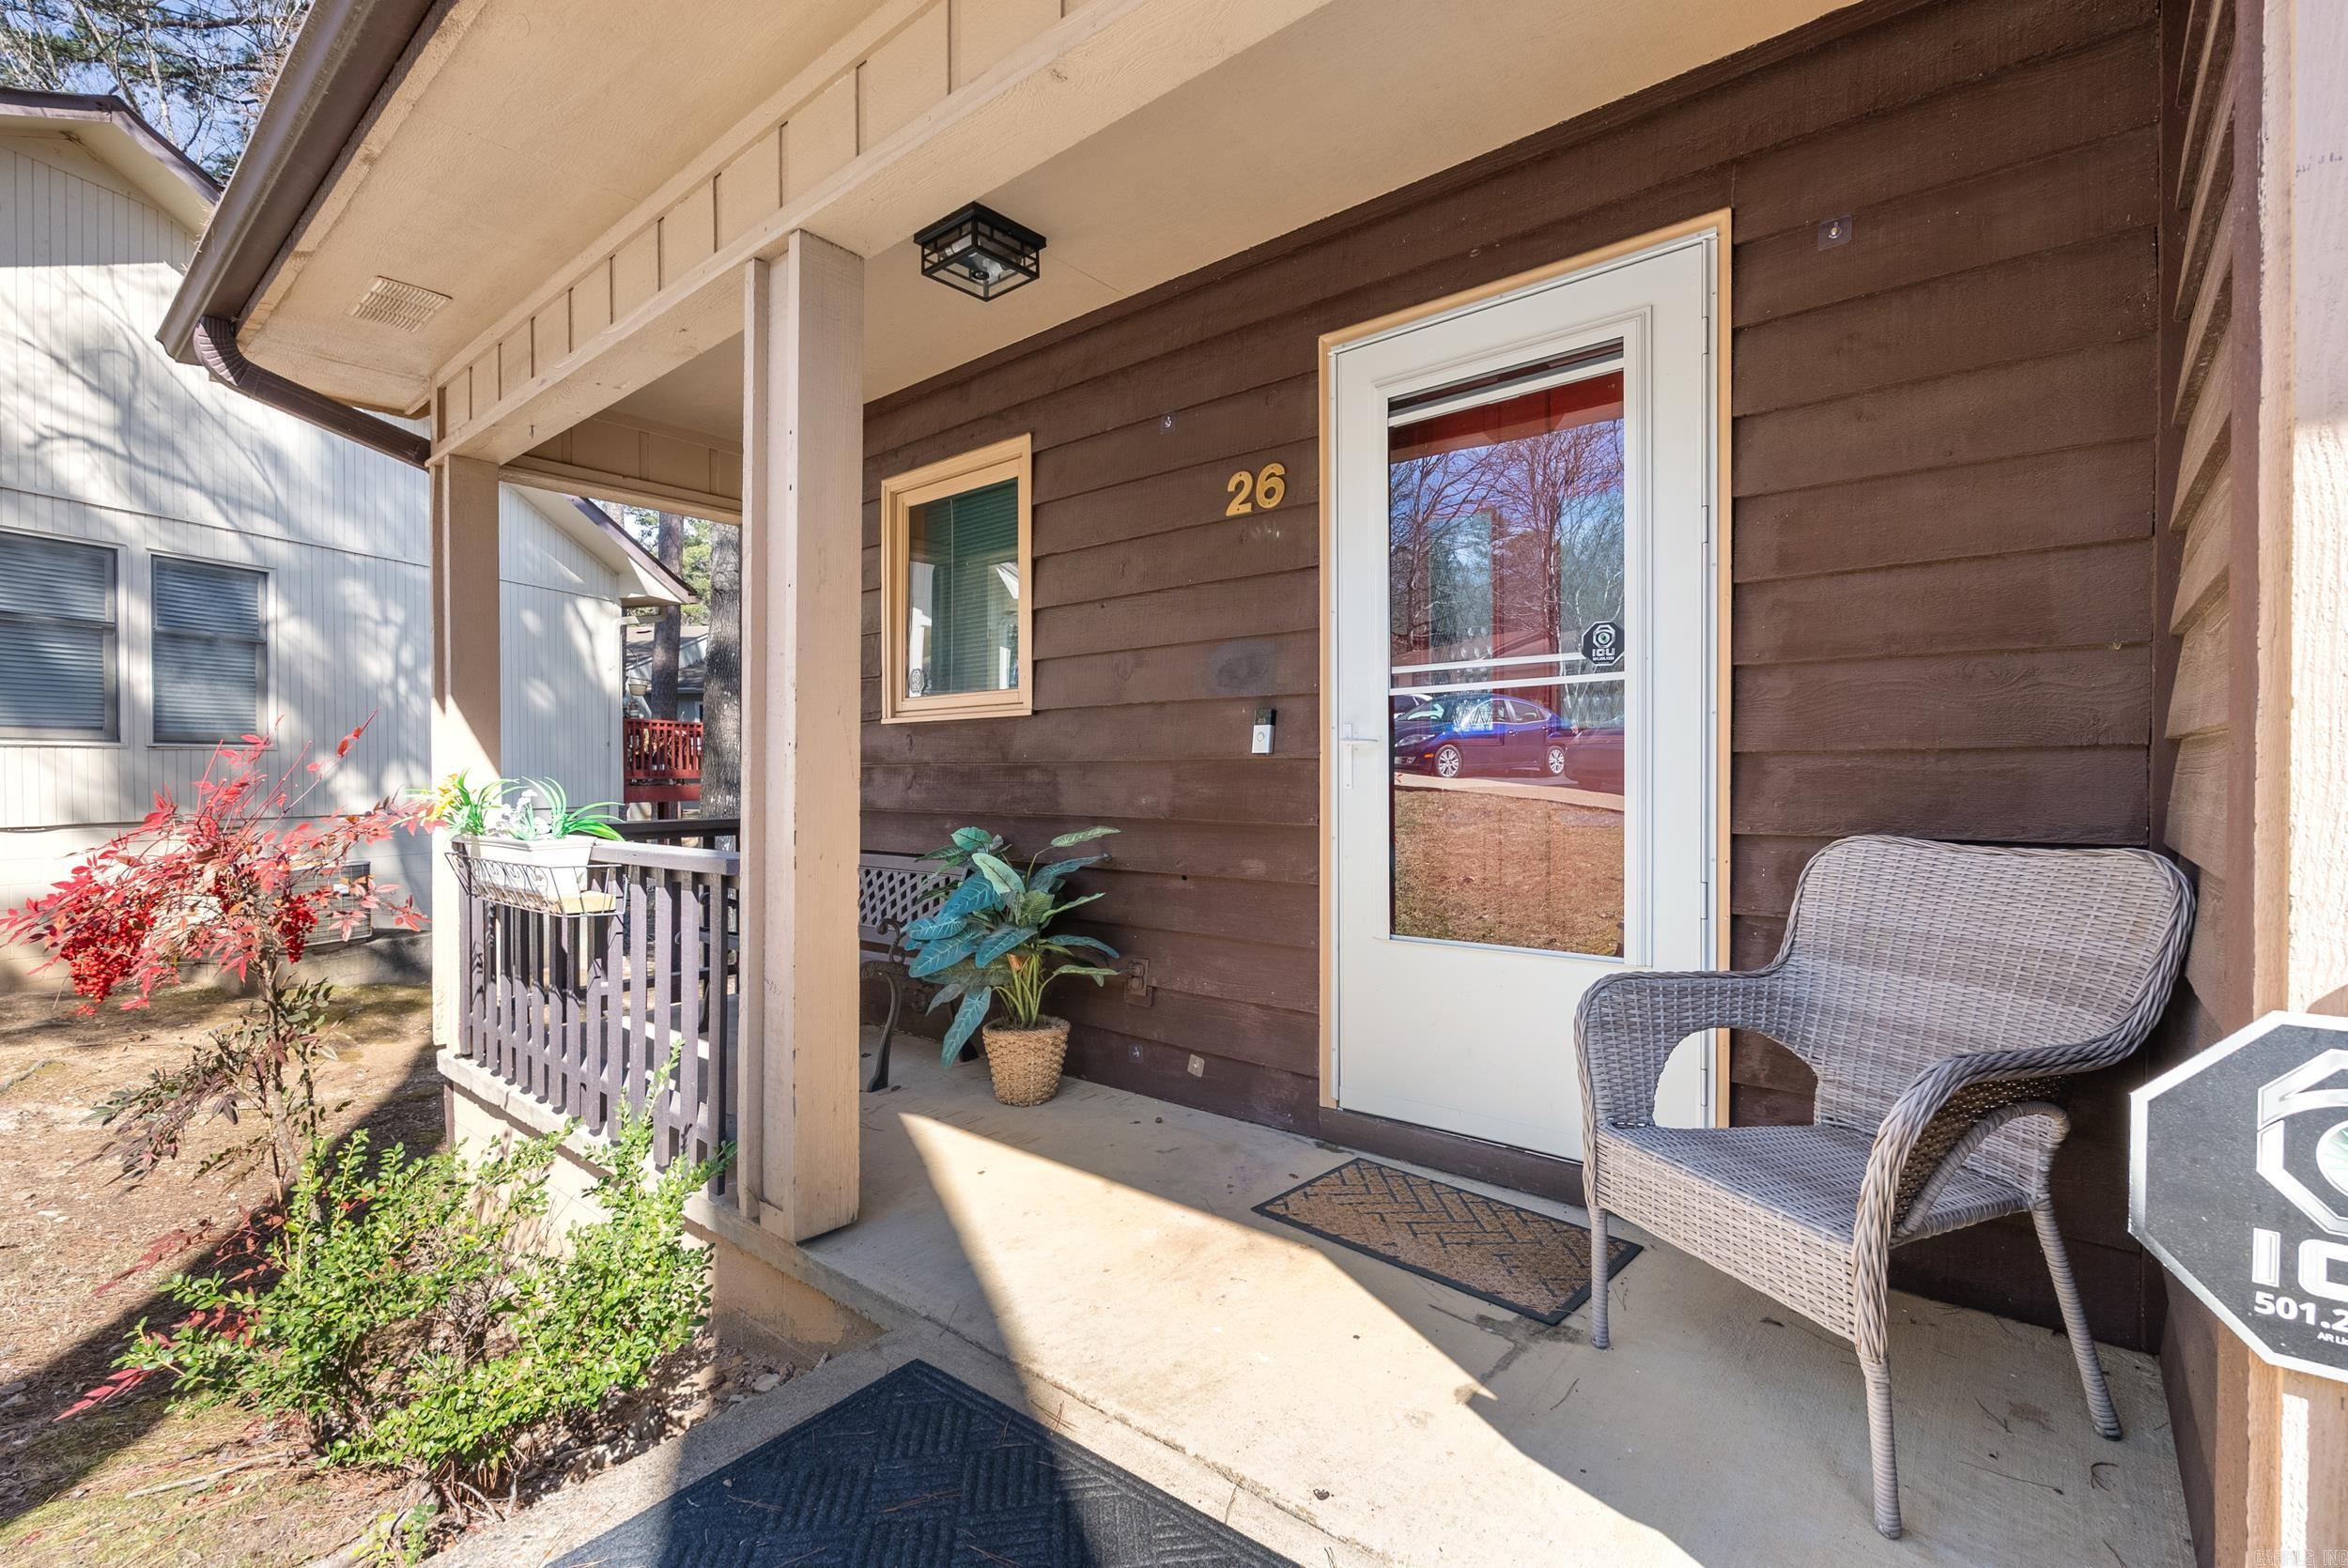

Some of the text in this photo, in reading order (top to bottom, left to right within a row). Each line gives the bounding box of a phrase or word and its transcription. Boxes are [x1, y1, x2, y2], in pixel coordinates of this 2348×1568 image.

[1226, 462, 1286, 516] 26
[1592, 648, 1615, 657] ICU
[2317, 1331, 2335, 1344] AR
